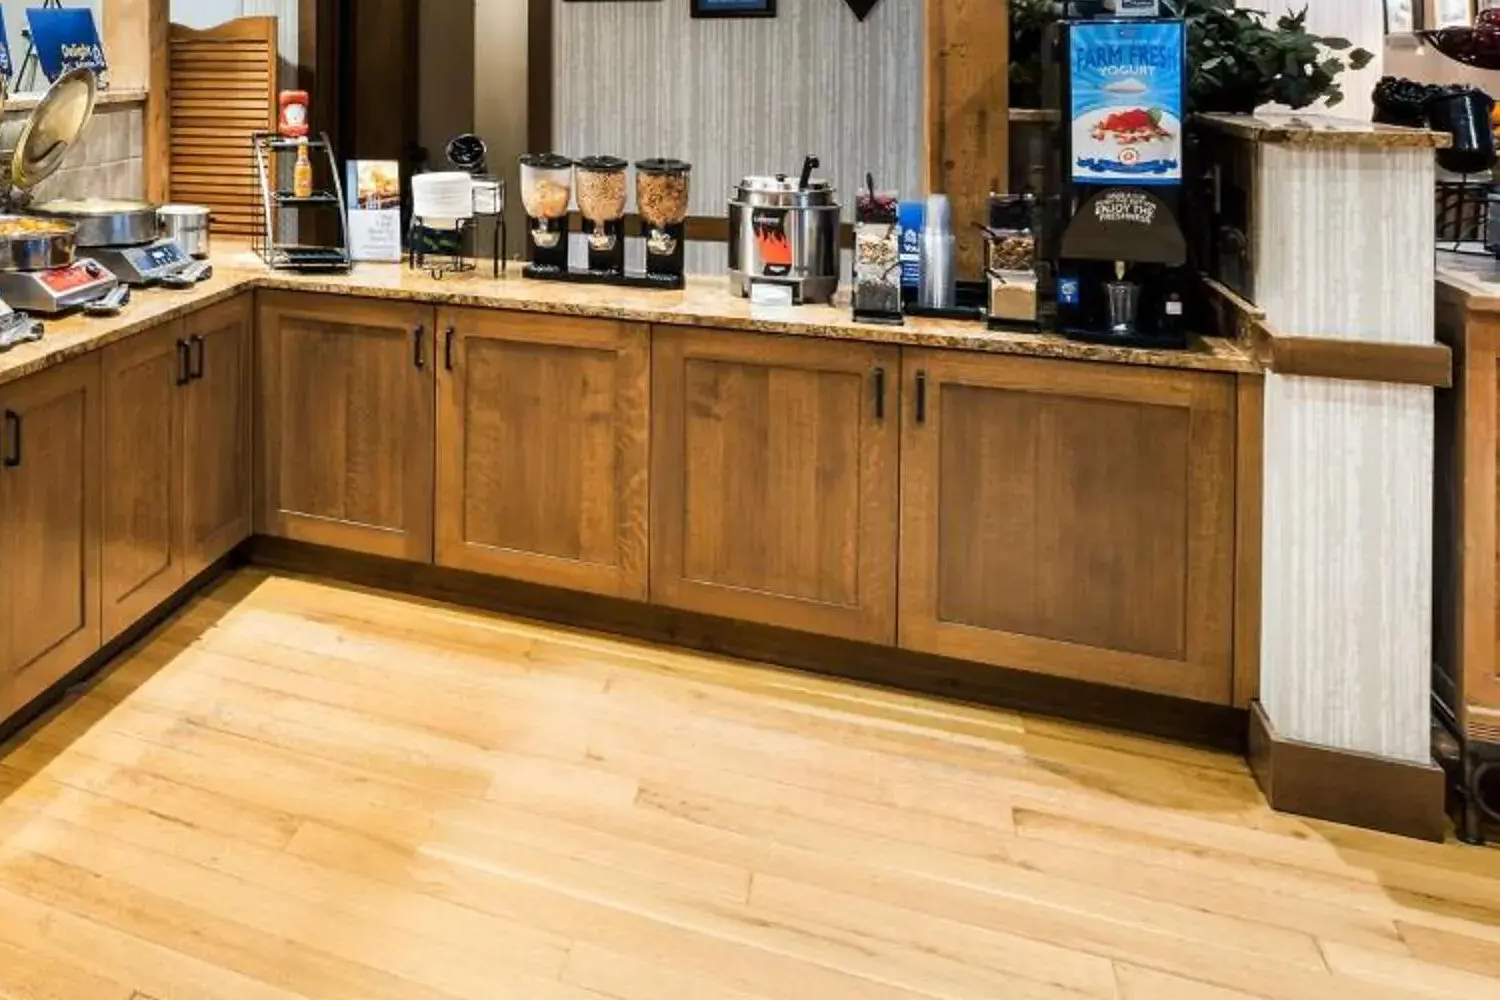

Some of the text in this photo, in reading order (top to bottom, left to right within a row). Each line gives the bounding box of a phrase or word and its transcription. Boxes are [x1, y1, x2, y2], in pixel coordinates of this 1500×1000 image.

[1077, 45, 1176, 69] FARM FRESH
[1100, 65, 1157, 77] YOGURT
